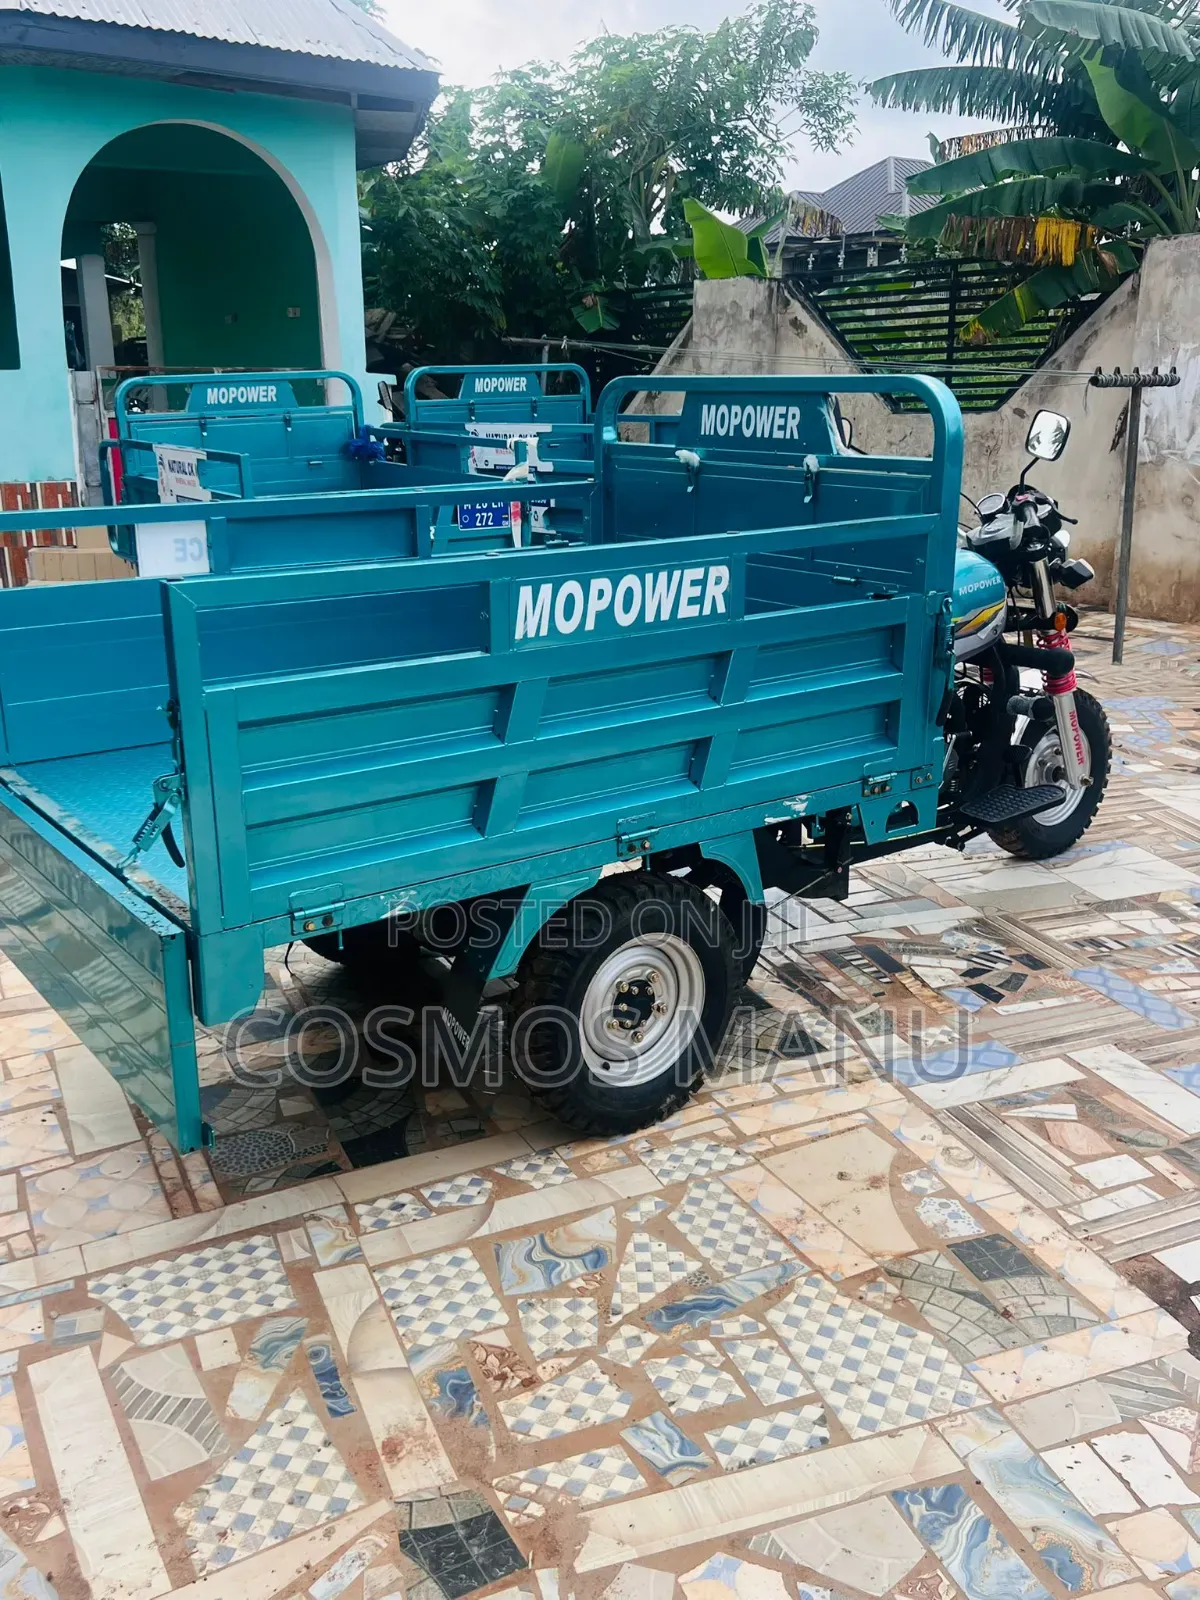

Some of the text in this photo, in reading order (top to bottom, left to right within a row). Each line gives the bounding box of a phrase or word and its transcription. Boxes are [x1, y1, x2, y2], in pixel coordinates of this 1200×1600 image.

[206, 385, 276, 405] MOPOWER
[474, 376, 527, 393] MOPOWER
[700, 404, 801, 440] MOPOWER
[475, 512, 494, 526] 272
[958, 575, 1001, 597] MOPOWER
[514, 565, 730, 640] MOPOWER
[1069, 710, 1085, 766] MOPOWER
